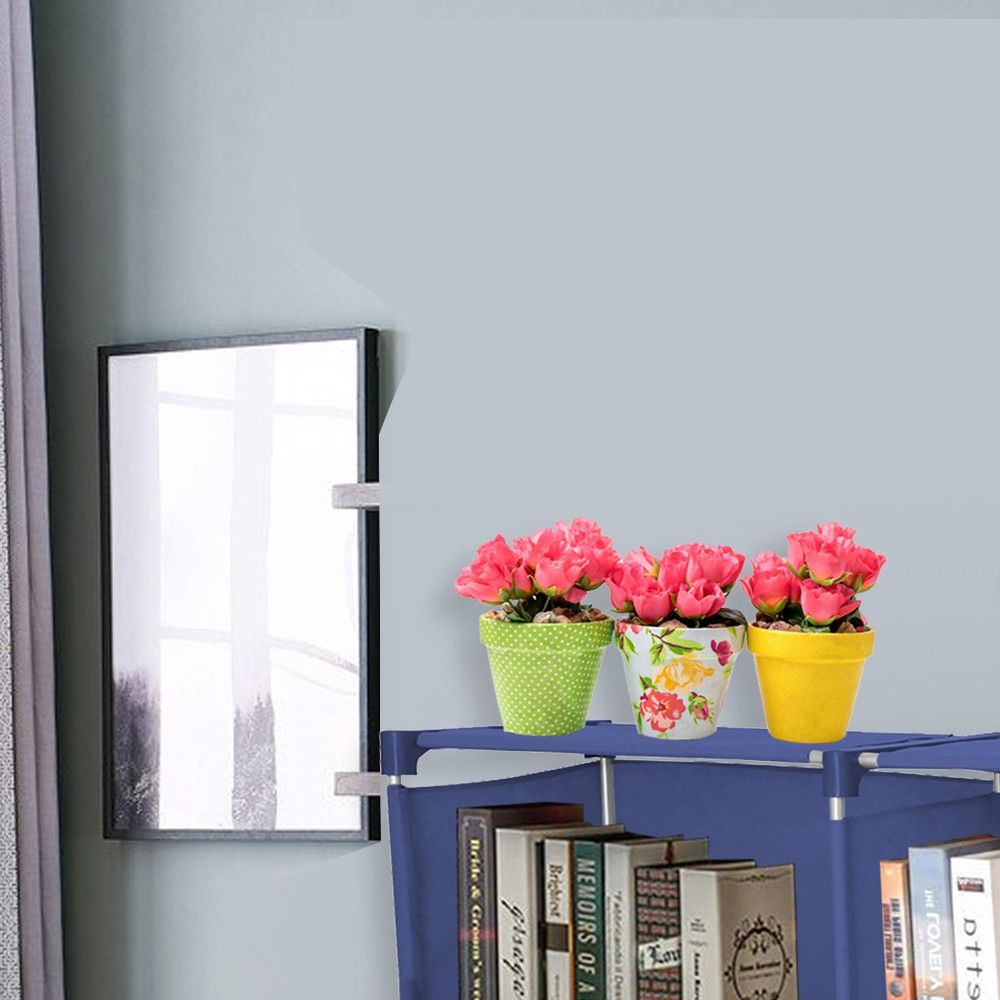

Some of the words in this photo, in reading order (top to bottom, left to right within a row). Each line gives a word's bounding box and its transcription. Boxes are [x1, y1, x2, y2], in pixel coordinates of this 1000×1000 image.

[577, 858, 596, 944] MEMOIRS
[578, 953, 595, 975] OF
[579, 982, 594, 993] A
